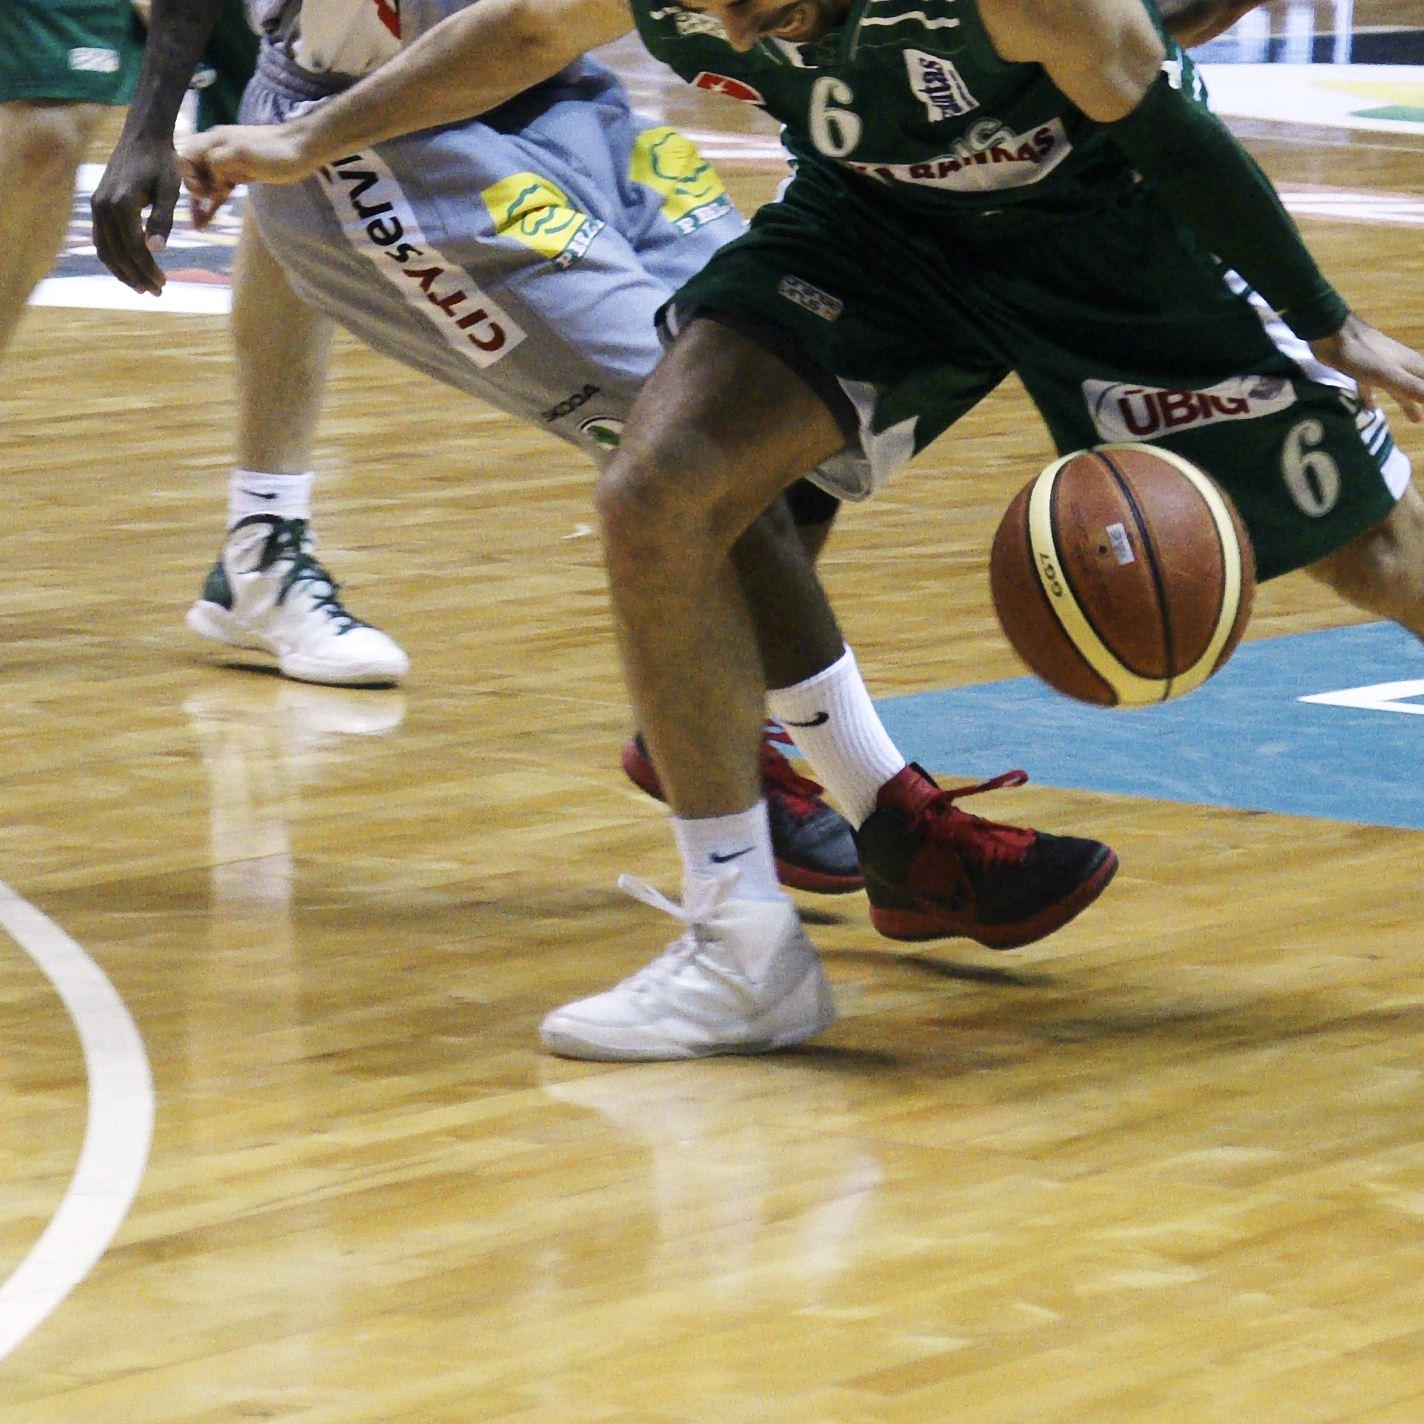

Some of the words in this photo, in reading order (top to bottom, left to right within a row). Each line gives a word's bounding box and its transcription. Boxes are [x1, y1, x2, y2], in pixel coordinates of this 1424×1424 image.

[809, 76, 861, 158] 6
[332, 153, 507, 353] CITYservi
[1281, 418, 1342, 518] 6
